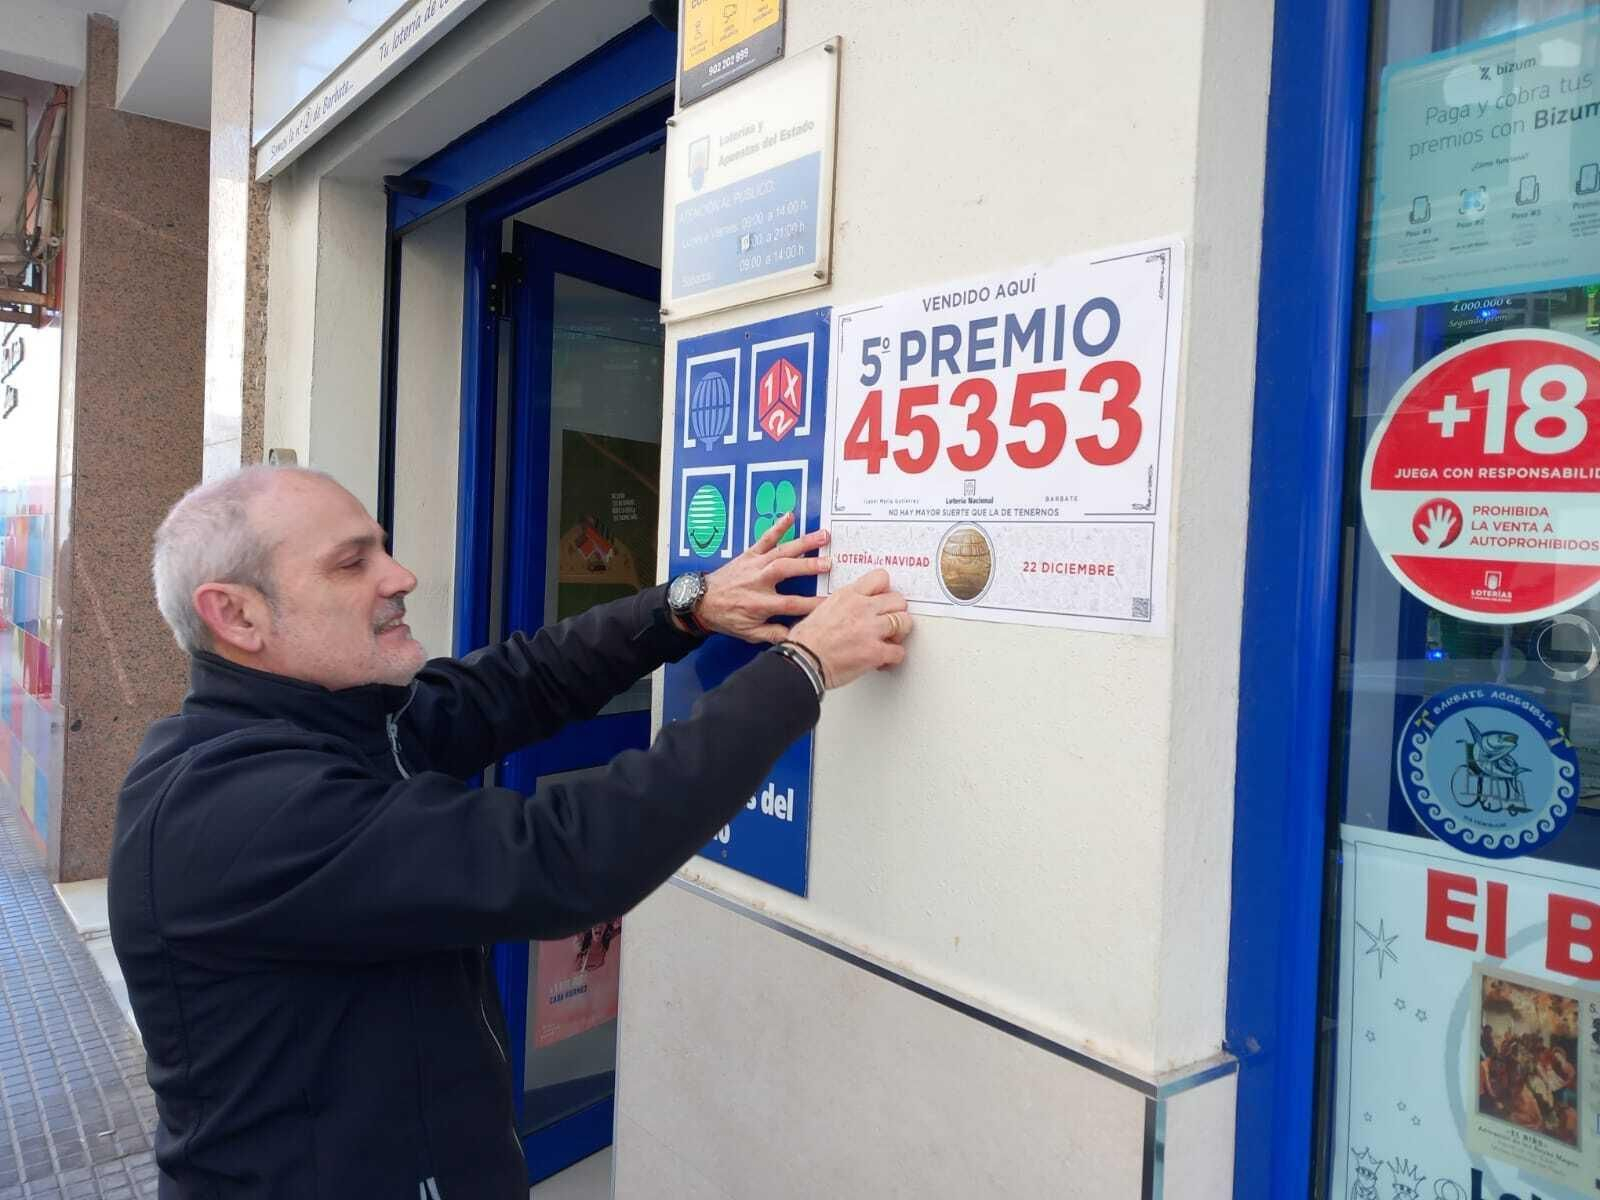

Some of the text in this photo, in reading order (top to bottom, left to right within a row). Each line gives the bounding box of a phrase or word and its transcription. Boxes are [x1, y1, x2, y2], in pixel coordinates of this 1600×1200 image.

[379, 41, 390, 62] Tu
[424, 0, 436, 22] de
[708, 61, 722, 76] 902
[1496, 57, 1537, 76] bizum
[1425, 72, 1594, 126] Paga y cobra tus
[761, 132, 777, 149] del
[780, 119, 815, 141] Estado
[1407, 128, 1485, 161] premios
[1490, 119, 1526, 140] con
[922, 272, 1037, 313] VENDIDO AQUÍ
[860, 296, 1121, 388] 5º PREMIO
[843, 360, 1143, 475] 45353
[1428, 364, 1588, 455] +18
[1394, 468, 1438, 479] JUEGA
[1443, 468, 1473, 479] CON
[968, 496, 994, 505] Nacional
[1045, 495, 1079, 503] BARBATE
[888, 507, 1060, 517] NO HAY MAYOR SUERTE QUE LA DE TENERNOS
[1472, 505, 1549, 517] PROHIBIDA
[1471, 520, 1554, 533] LA VENTA A
[1470, 535, 1599, 551] AUTOPROHIBIDOS
[837, 551, 873, 564] LOTERÍA
[884, 555, 930, 568] NAVIDAD
[1023, 561, 1116, 577] 22 DICIEMBRE
[760, 782, 795, 822] del
[1425, 867, 1509, 960] El
